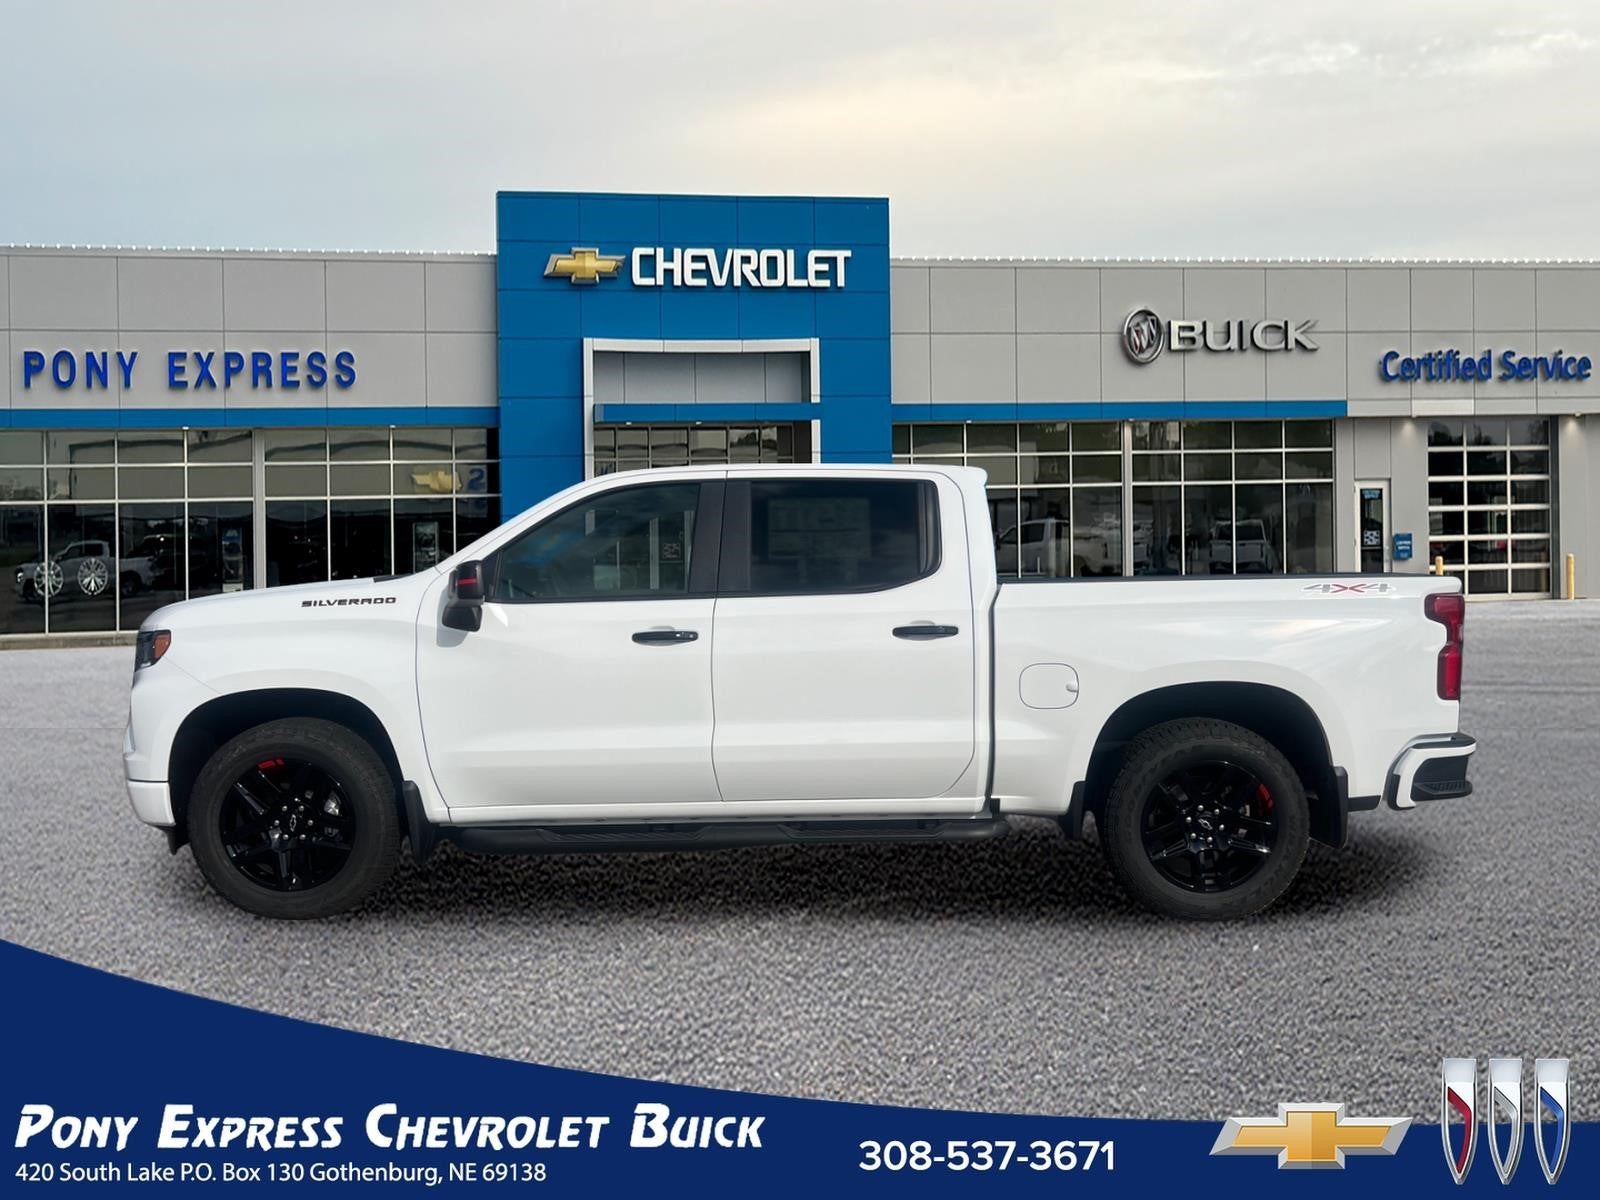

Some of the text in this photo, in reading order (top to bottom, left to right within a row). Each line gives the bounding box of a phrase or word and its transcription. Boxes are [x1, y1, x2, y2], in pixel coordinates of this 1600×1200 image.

[631, 247, 852, 288] CHEVROLET
[1168, 319, 1319, 352] BUICK
[23, 350, 357, 390] PONY EXPRESS
[1381, 349, 1592, 381] Certified Service
[301, 596, 397, 608] SILVERADO
